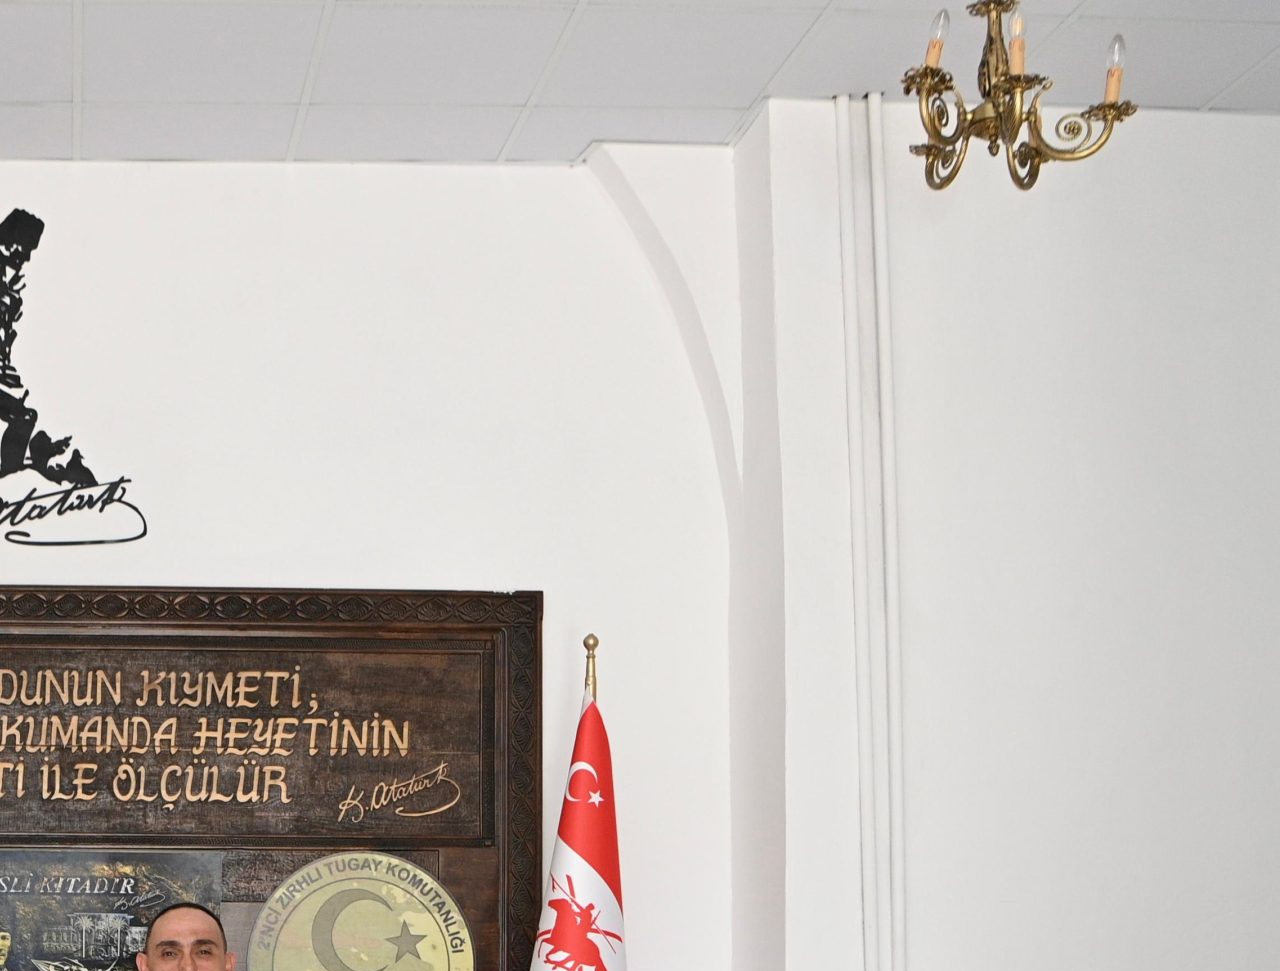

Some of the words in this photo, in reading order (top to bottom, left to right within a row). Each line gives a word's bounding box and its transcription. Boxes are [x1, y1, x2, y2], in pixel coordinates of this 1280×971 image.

[191, 711, 410, 757] HEYETİNİN
[40, 756, 99, 801] İLE
[111, 757, 293, 811] ÖLÇÜLÜR
[39, 876, 135, 894] KITADIR
[276, 869, 324, 910] ZIRHLI
[324, 857, 384, 876] TUGAY
[385, 861, 468, 954] KOMUTANLIĞI
